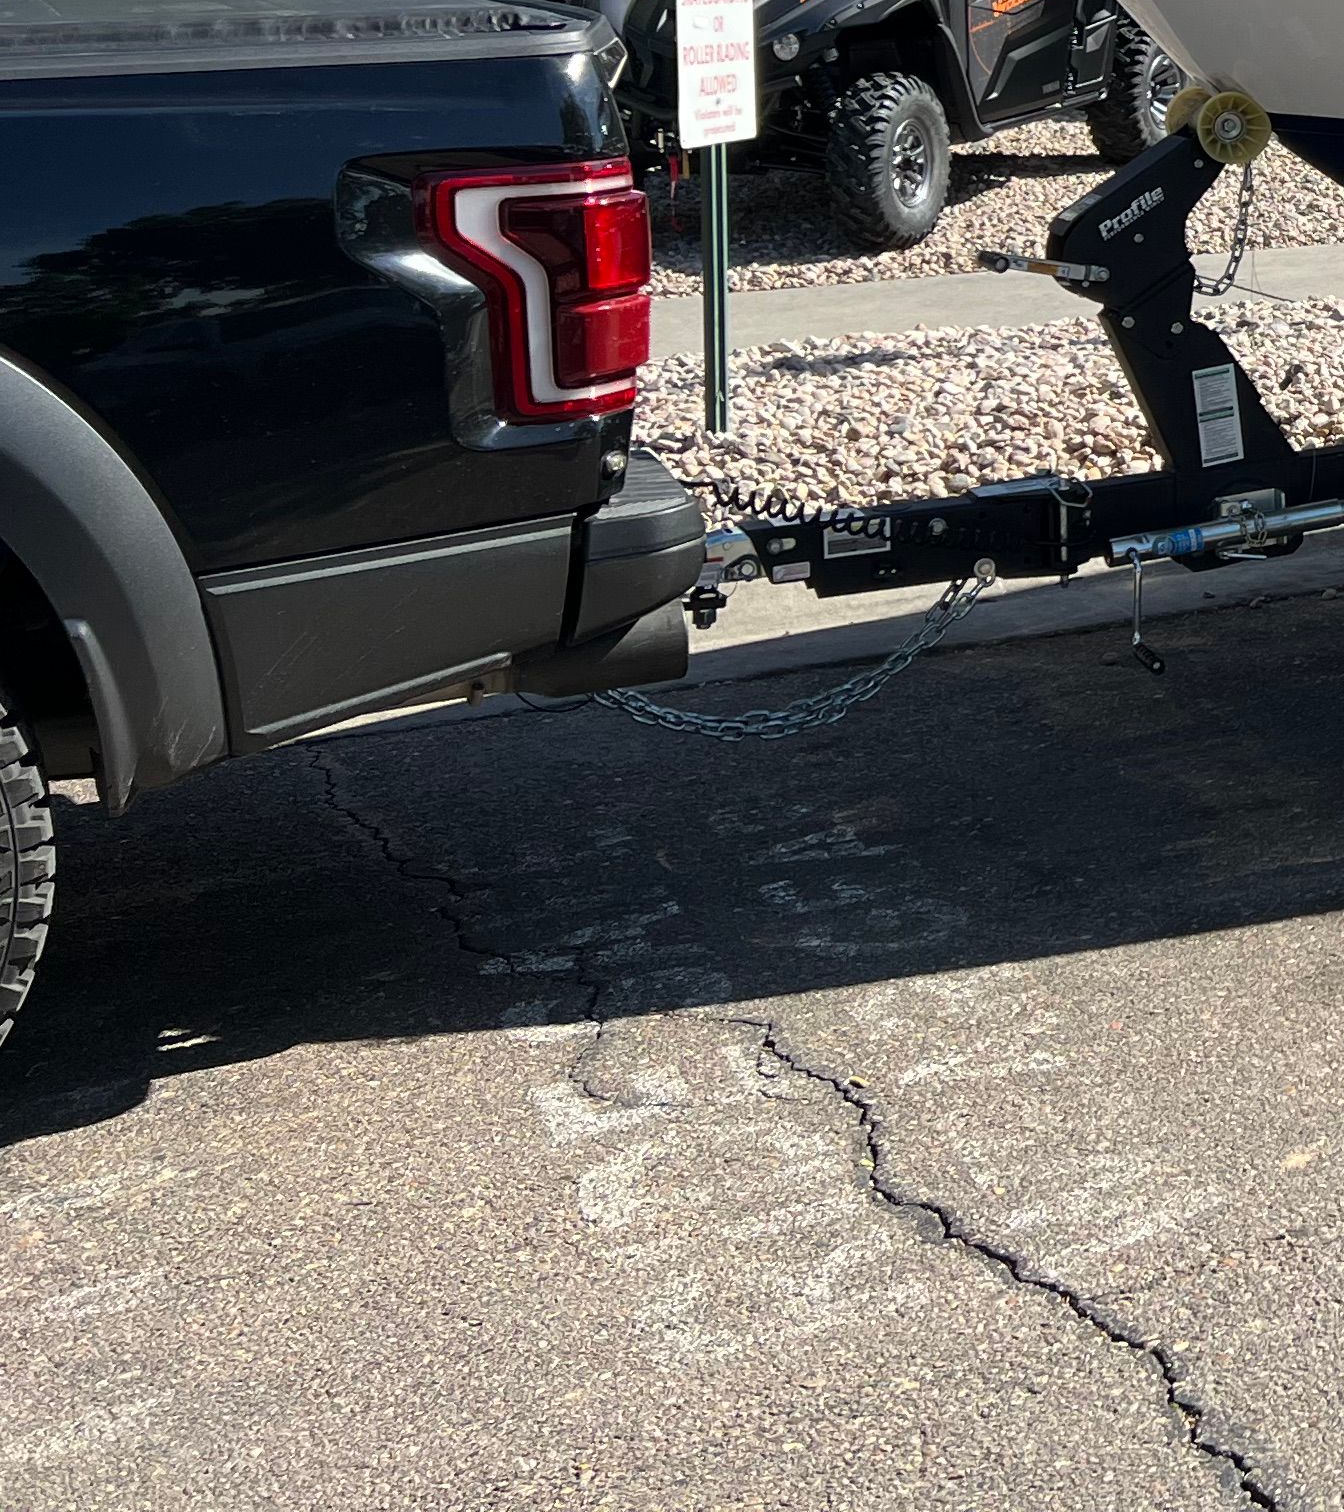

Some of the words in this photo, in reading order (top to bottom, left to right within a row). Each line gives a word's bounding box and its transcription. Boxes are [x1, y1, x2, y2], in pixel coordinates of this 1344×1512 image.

[712, 15, 725, 34] OR
[683, 44, 715, 67] ROLLER
[717, 41, 751, 64] BLADING
[698, 73, 739, 98] ALLOWED
[1098, 186, 1164, 239] Profile
